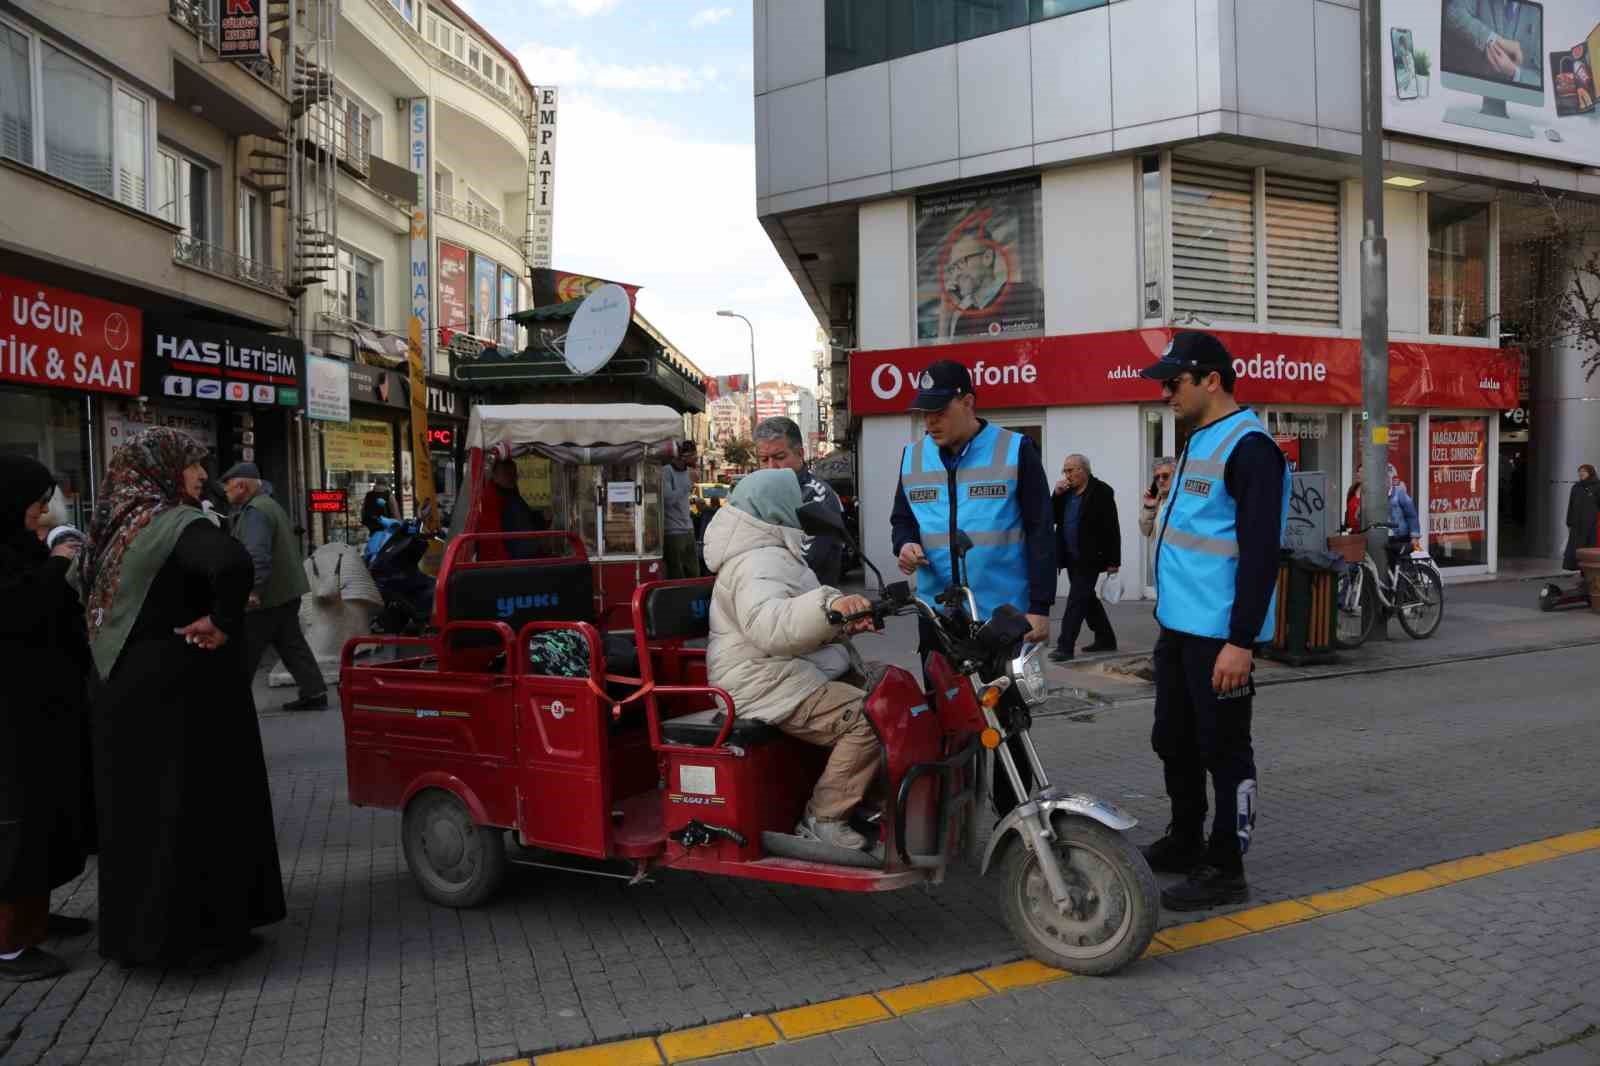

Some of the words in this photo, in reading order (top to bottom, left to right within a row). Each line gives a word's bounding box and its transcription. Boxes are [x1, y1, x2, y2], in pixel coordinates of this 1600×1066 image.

[540, 90, 556, 206] EMPATİ
[13, 292, 83, 337] UĞUR
[46, 346, 66, 381] &
[73, 352, 135, 390] SAAT
[156, 334, 222, 365] HAS
[1231, 352, 1328, 381] odafone
[907, 361, 1037, 390] vfone
